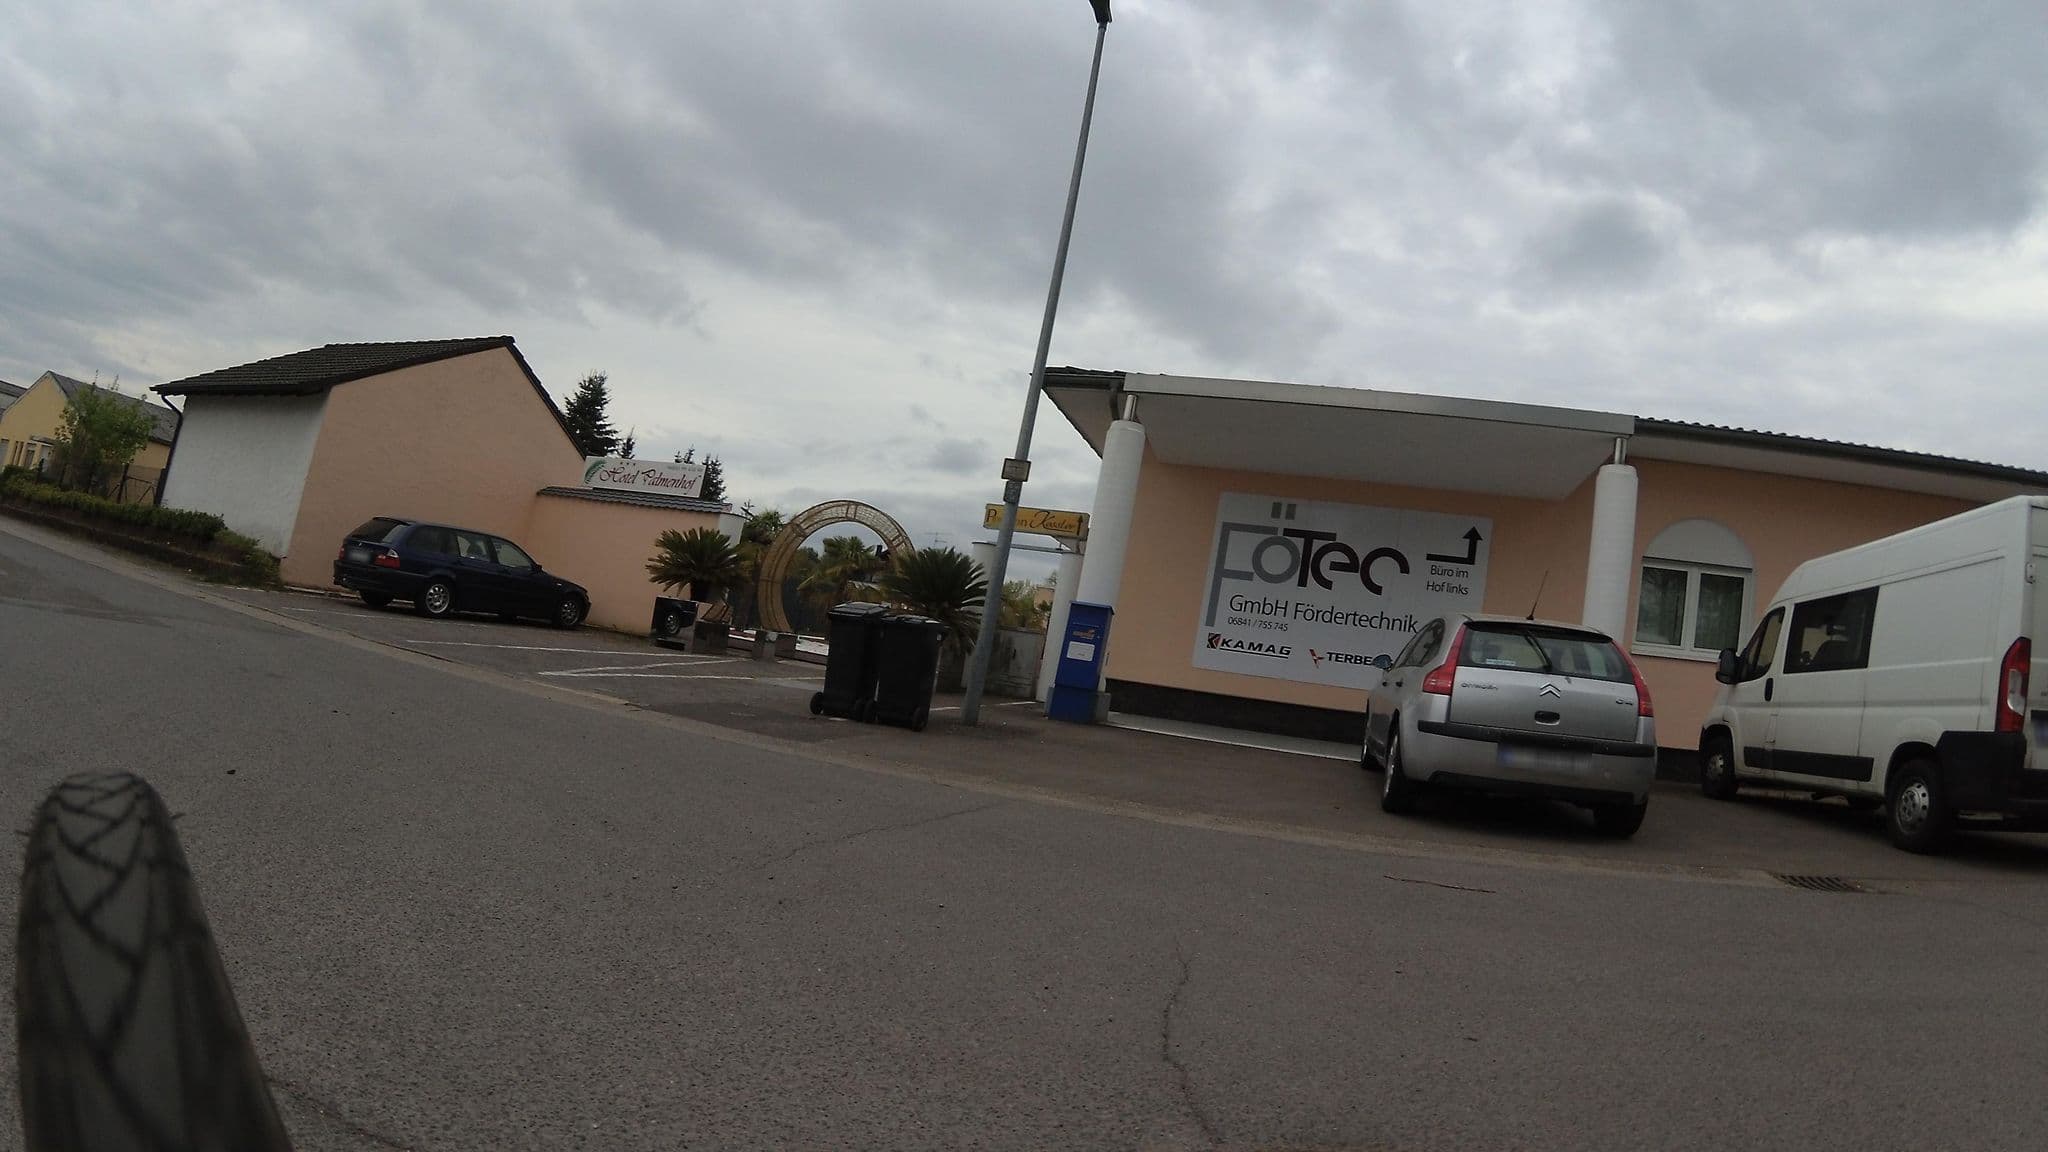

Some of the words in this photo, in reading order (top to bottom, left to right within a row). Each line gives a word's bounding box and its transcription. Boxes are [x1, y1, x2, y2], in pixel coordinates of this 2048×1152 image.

[600, 466, 639, 485] Hotel
[641, 469, 698, 490] Palmenhof
[1430, 564, 1454, 577] Büro
[1455, 567, 1469, 578] im
[1426, 581, 1446, 592] Hof
[1446, 582, 1469, 595] links
[1229, 594, 1288, 617] GmbH
[1294, 602, 1419, 633] Fördertechnik
[1227, 616, 1251, 627] 06841
[1258, 620, 1273, 630] 755
[1274, 622, 1289, 632] 745
[1221, 637, 1292, 656] KAMAG
[1326, 651, 1374, 667] TERBE
